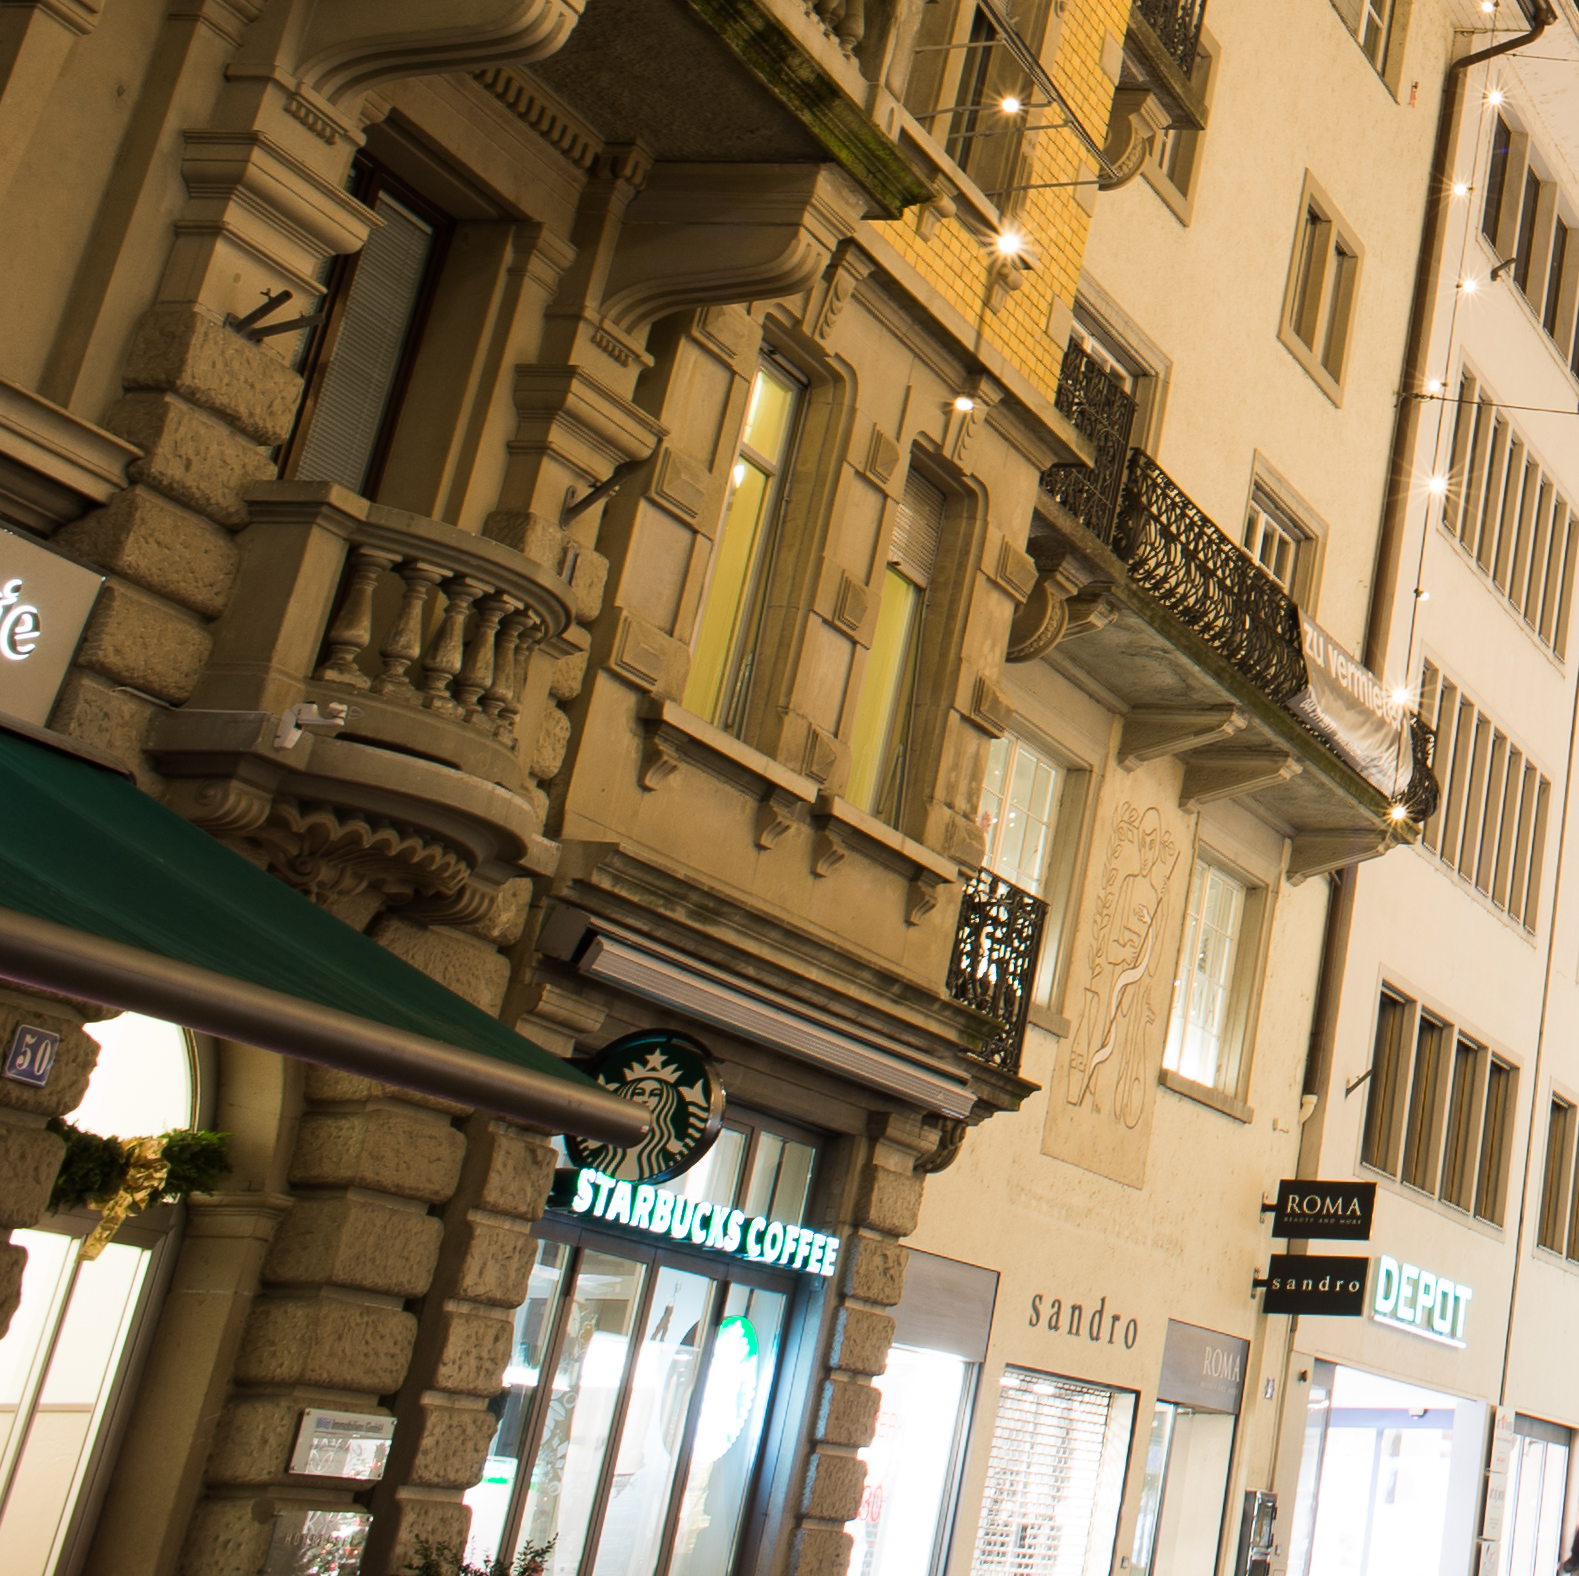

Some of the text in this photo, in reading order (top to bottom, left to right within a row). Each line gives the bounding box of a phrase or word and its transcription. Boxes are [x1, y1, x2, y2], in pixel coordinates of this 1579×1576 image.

[1304, 622, 1325, 668] zu
[16, 1034, 51, 1076] 50
[572, 1168, 840, 1277] STARBUCKS COFFEE
[1286, 1194, 1361, 1216] ROMA
[1271, 1275, 1360, 1292] sandro
[1374, 1254, 1473, 1338] DEPOT
[1029, 1293, 1138, 1349] sandro
[1202, 1346, 1240, 1382] ROMA
